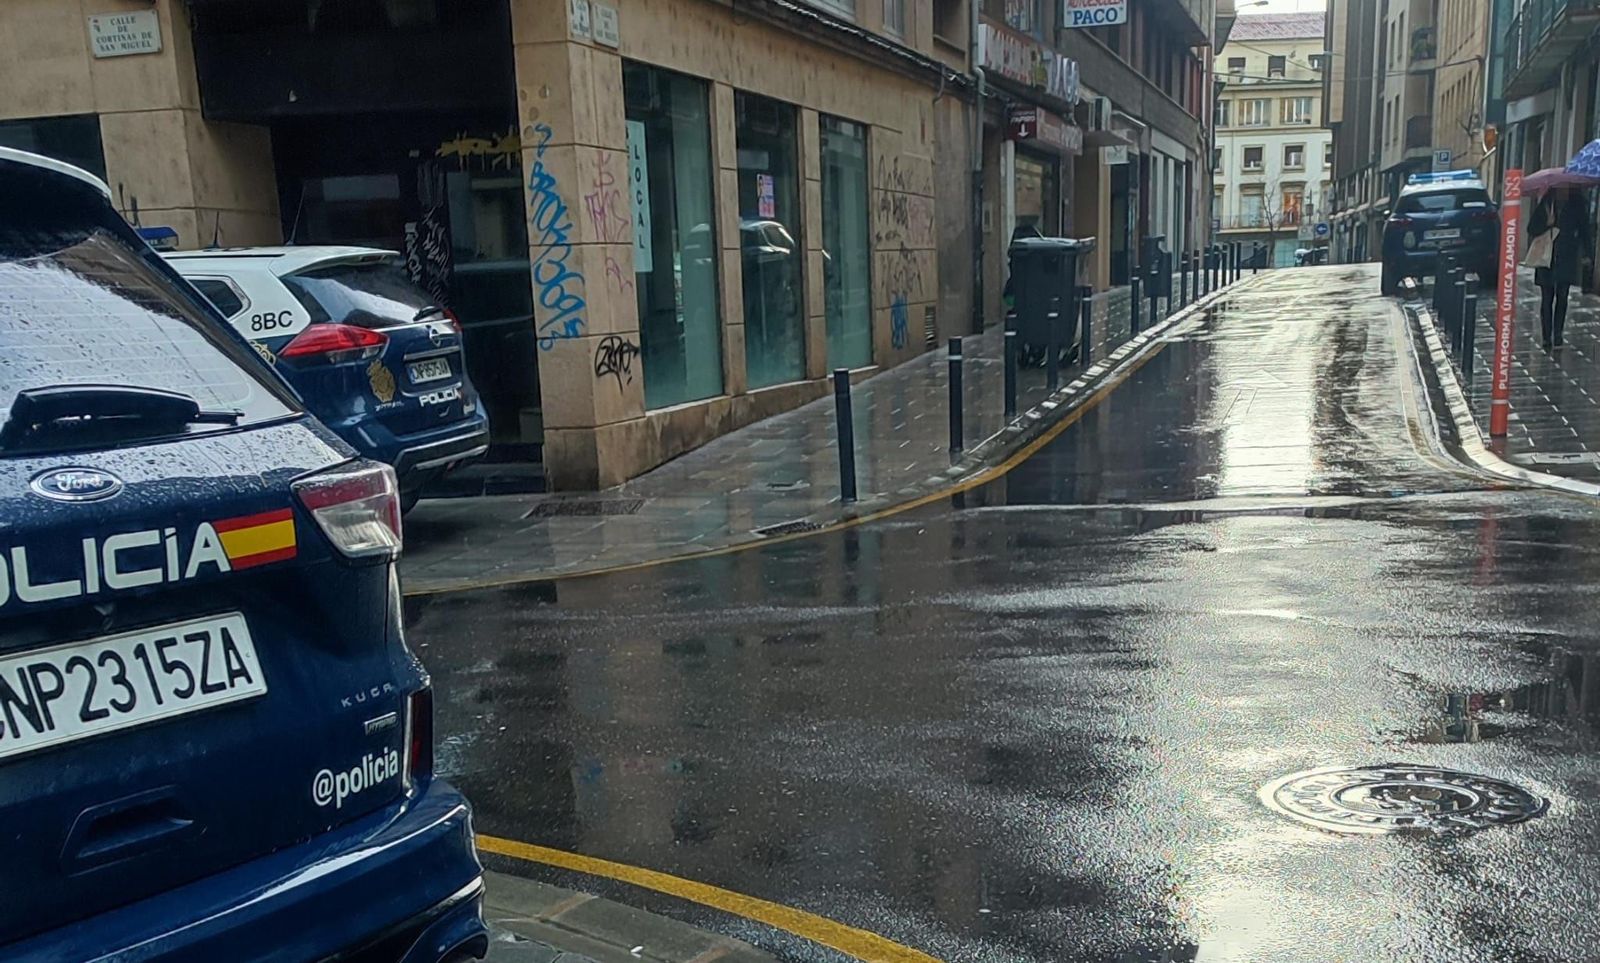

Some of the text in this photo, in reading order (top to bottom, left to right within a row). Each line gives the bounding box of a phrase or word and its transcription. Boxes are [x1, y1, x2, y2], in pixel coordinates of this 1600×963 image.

[110, 16, 136, 25] CALLE
[117, 25, 128, 33] DE
[96, 32, 153, 44] CORTINAS DE
[100, 41, 152, 52] SAN MIGUEL
[634, 144, 645, 249] LOCAL
[1499, 314, 1511, 390] PLATAFORMA
[1505, 218, 1517, 269] ZAMORA
[251, 310, 293, 331] 8BC
[55, 472, 104, 492] Ford
[0, 627, 253, 740] NP2315ZA
[313, 746, 398, 808] @policia
